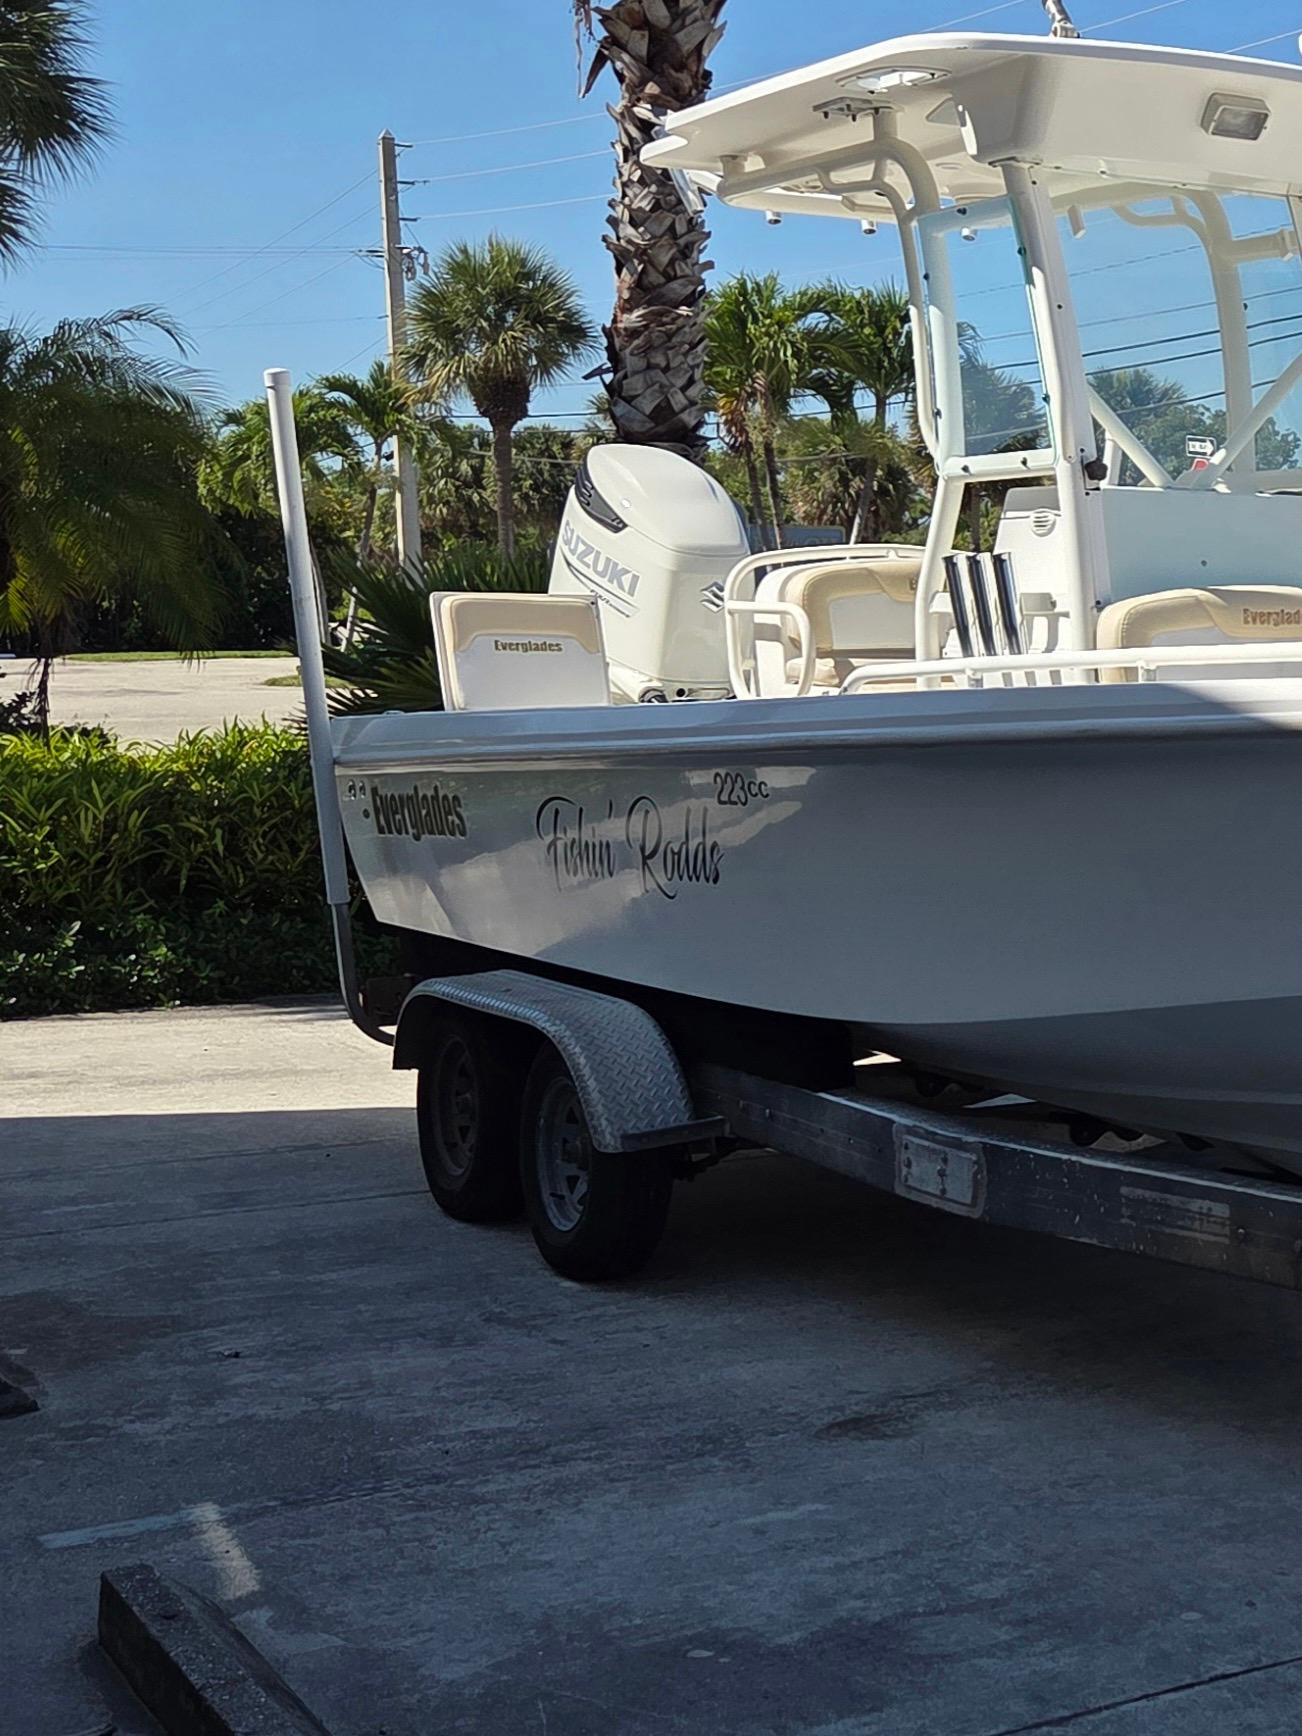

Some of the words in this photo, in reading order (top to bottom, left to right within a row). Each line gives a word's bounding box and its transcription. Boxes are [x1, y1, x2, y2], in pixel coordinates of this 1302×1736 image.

[562, 520, 640, 597] SUZUKI
[494, 639, 563, 653] Everglades
[371, 784, 467, 842] Everglades
[714, 772, 770, 806] 223cc
[536, 796, 616, 892] Fishin'
[626, 796, 725, 900] Rodds
